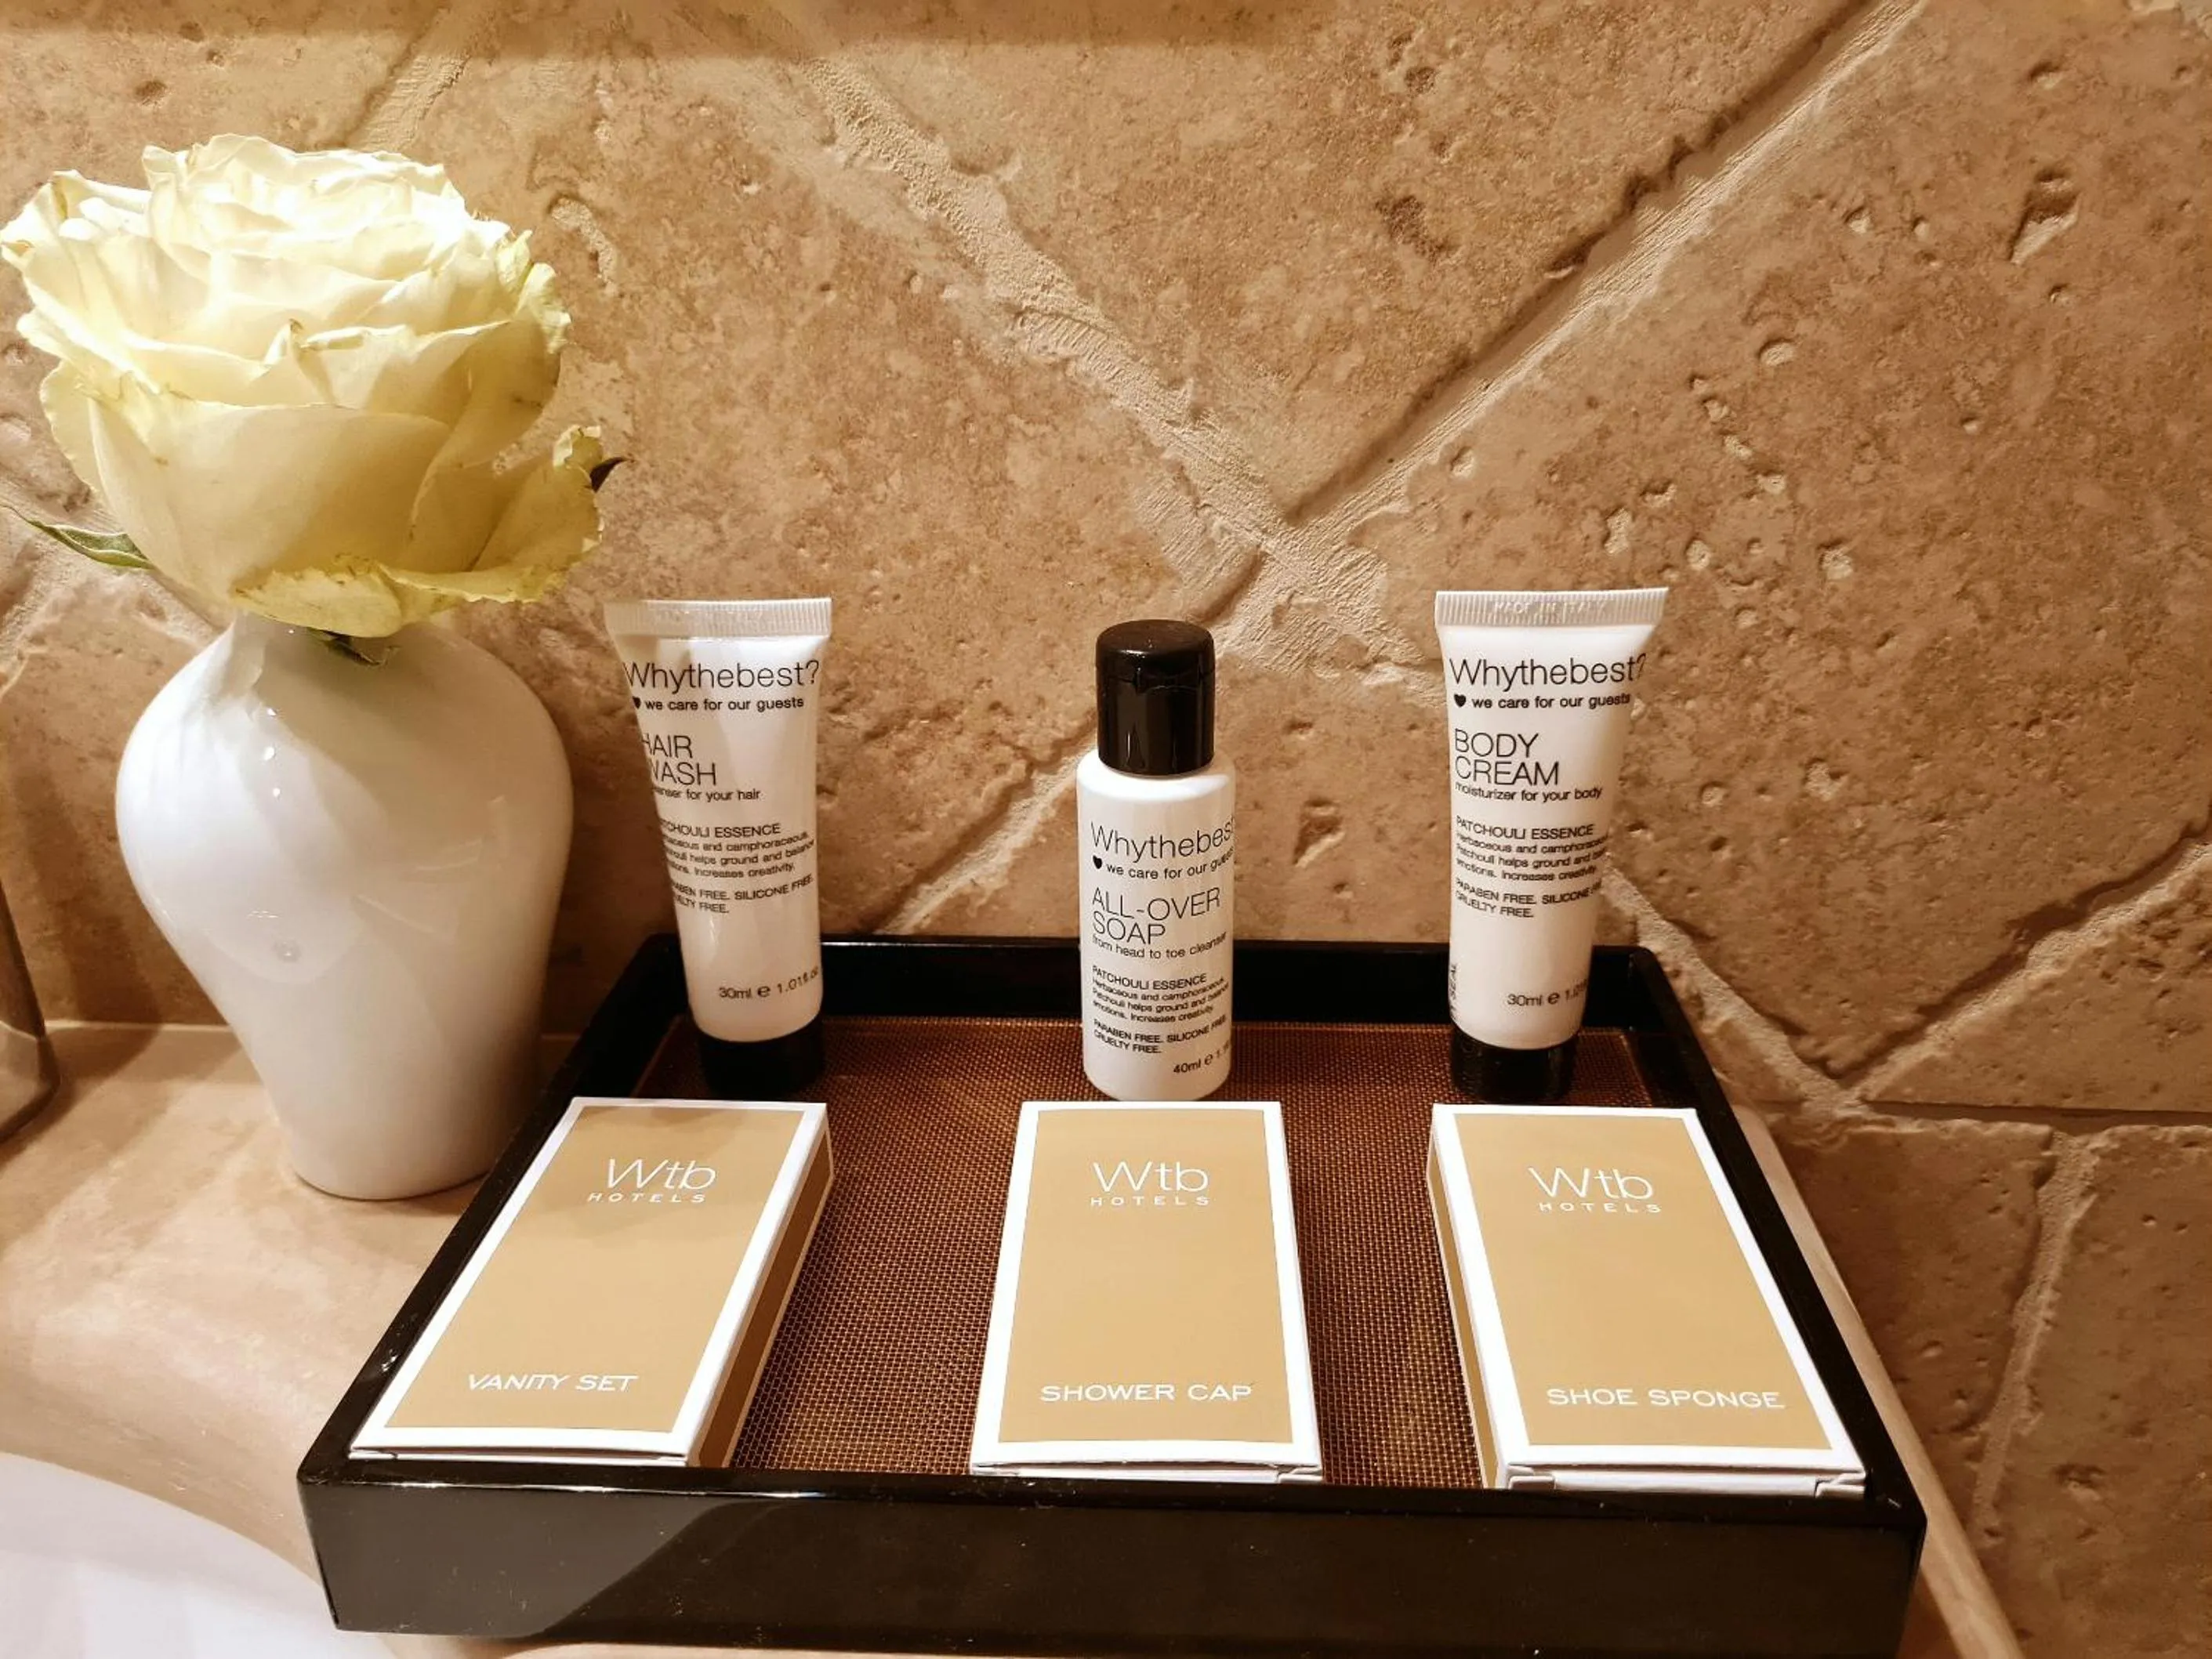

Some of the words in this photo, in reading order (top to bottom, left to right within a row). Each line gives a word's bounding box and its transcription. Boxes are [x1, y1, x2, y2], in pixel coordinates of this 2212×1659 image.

[622, 659, 820, 694] Whythebest?
[1449, 652, 1646, 693] Whythebest?
[644, 699, 663, 711] we
[669, 699, 698, 711] care
[703, 698, 722, 711] for
[727, 698, 752, 711] our
[756, 697, 804, 713] guests
[1471, 697, 1492, 709] we
[1498, 697, 1529, 709] care
[1534, 695, 1554, 708] for
[1559, 696, 1583, 708] our
[1455, 727, 1539, 759] BODY
[1455, 755, 1560, 787] CREAM
[686, 788, 702, 800] for
[706, 789, 734, 803] your
[738, 788, 760, 800] hair
[1455, 782, 1517, 801] moisturizer
[1521, 789, 1539, 802] for
[1543, 789, 1570, 803] your
[1574, 786, 1602, 800] body
[714, 823, 782, 839] ESSENCE
[1456, 815, 1526, 840] PATCHOULI
[1531, 824, 1595, 840] ESSENCE
[703, 842, 723, 852] and
[1515, 844, 1538, 853] and
[690, 853, 716, 866] helps
[720, 854, 759, 867] ground
[762, 849, 782, 862] and
[1498, 855, 1528, 869] helps
[1532, 856, 1571, 870] ground
[1106, 863, 1124, 875] we
[1128, 867, 1159, 880] care
[1163, 867, 1183, 879] for
[1186, 862, 1208, 877] our
[734, 884, 789, 901] SILICONE
[698, 903, 730, 914] FREE.
[1092, 886, 1220, 921] ALL-OVER
[1092, 910, 1166, 945] SOAP
[1092, 933, 1113, 952] from
[1115, 944, 1145, 958] head
[1148, 948, 1162, 959] to
[1165, 947, 1186, 958] toe
[1092, 965, 1150, 991] PATCHOULI
[1152, 973, 1208, 991] ESSENCE
[718, 986, 753, 1000] 30ml
[1140, 991, 1160, 1002] and
[1507, 992, 1543, 1007] 30ml
[1126, 998, 1153, 1013] helps
[1155, 1001, 1189, 1014] ground
[1190, 996, 1206, 1009] and
[1093, 1018, 1132, 1041] PARABEN
[1166, 1025, 1210, 1043] SILICONE
[1093, 1029, 1130, 1051] CRUELTY
[1132, 1042, 1162, 1054] FREE.
[1173, 1059, 1202, 1074] 40ml
[607, 1157, 717, 1190] Wtb
[1092, 1161, 1209, 1193] Wtb
[1528, 1166, 1654, 1201] Wtb
[587, 1192, 707, 1204] HOTELS
[1090, 1195, 1210, 1207] HOTELS
[1538, 1202, 1663, 1214] HOTELS
[468, 1373, 571, 1391] VANITY
[575, 1374, 640, 1393] SET
[1039, 1383, 1176, 1403] SHOWER
[1187, 1383, 1253, 1402] CAP
[1546, 1387, 1638, 1406] SHOE
[1648, 1389, 1787, 1410] SPONGE
